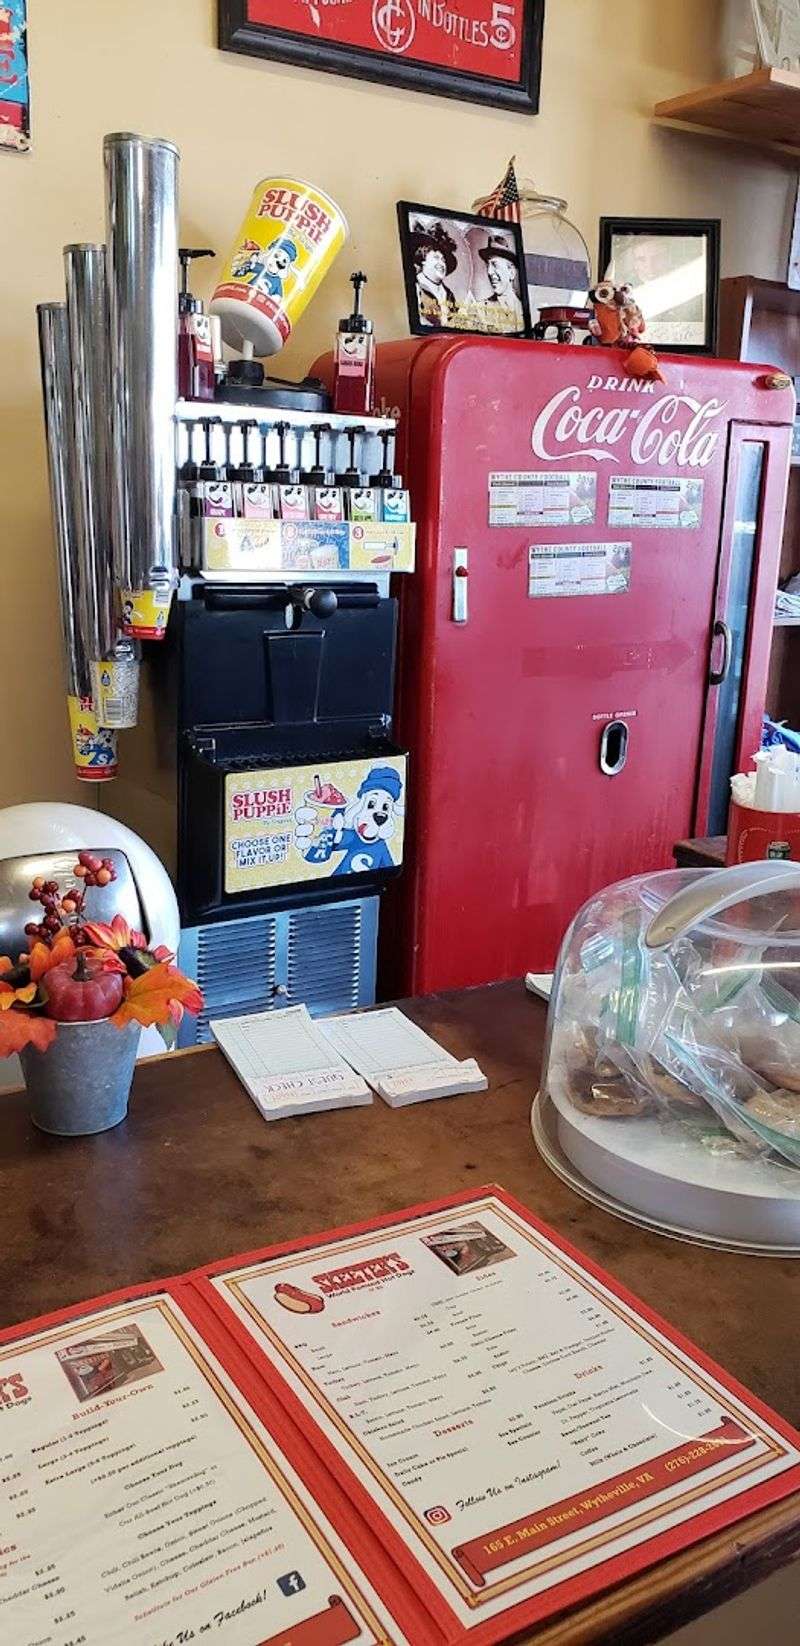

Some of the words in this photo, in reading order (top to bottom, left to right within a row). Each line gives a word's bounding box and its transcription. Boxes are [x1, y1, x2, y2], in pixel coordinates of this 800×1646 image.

[431, 1, 490, 47] BOTTLES
[587, 374, 656, 394] DRINK
[530, 385, 728, 467] Coca-Cola
[232, 788, 292, 809] SLUSH
[231, 836, 270, 850] CHOOSE
[271, 834, 291, 844] ONE
[236, 846, 272, 859] FLAVOR
[273, 844, 287, 852] OR
[239, 856, 256, 866] MIX
[258, 855, 267, 864] IT
[331, 1311, 381, 1327] Sandwiches
[573, 1365, 603, 1379] Drinks
[72, 1384, 154, 1420] Build-Your-Own
[433, 1420, 473, 1437] Desserts
[124, 1476, 150, 1490] Choose
[151, 1468, 168, 1477] Your
[169, 1461, 183, 1470] Dog
[455, 1495, 486, 1511] Follow
[486, 1488, 502, 1497] Us
[514, 1460, 560, 1485] Instagram!
[483, 1540, 505, 1555] 165
[519, 1521, 548, 1541] Main
[547, 1506, 582, 1530] Street,
[581, 1480, 638, 1512] Wytheville,
[636, 1472, 655, 1485] VA
[137, 1525, 165, 1539] Choose
[165, 1516, 183, 1526] Your
[184, 1586, 198, 1596] Our
[176, 1630, 195, 1644] Us
[200, 1623, 211, 1633] on
[213, 1589, 266, 1627] Facebook!
